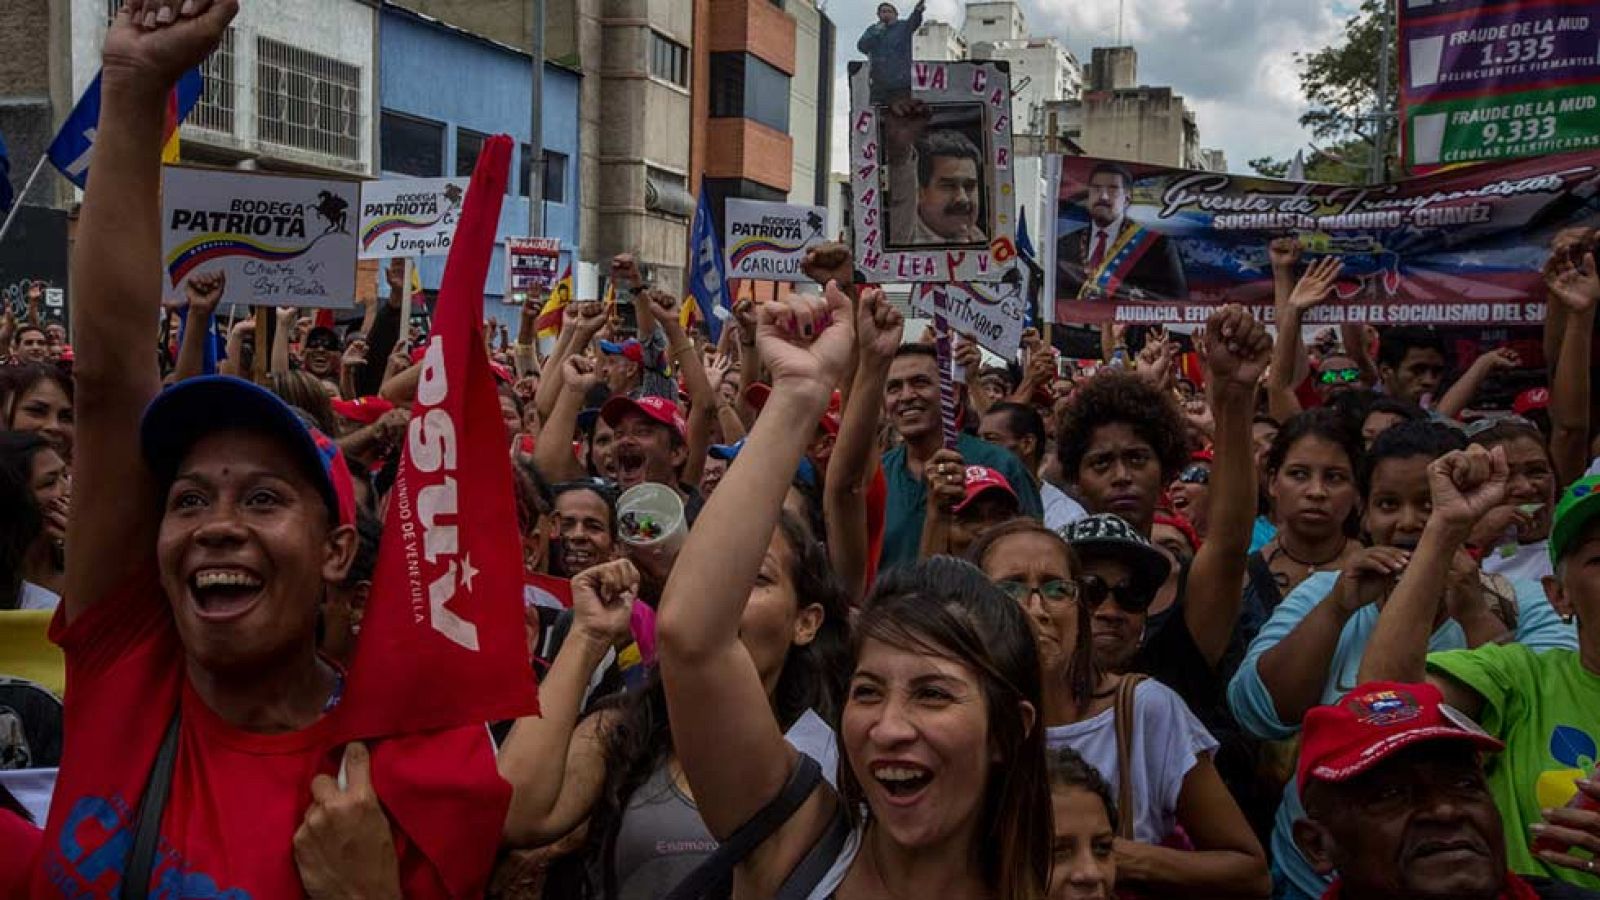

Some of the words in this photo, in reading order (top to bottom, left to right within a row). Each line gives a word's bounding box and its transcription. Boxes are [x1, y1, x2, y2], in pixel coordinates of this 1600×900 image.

[1450, 25, 1508, 46] FRAUDE
[1512, 22, 1532, 37] DE
[1534, 18, 1553, 34] LA
[1557, 17, 1589, 32] MUD
[1480, 36, 1556, 66] 1.335
[1530, 57, 1594, 71] FIRMANTES
[1452, 107, 1510, 125] FRAUDE
[1513, 103, 1533, 118] DE
[1536, 99, 1554, 115] LA
[1559, 95, 1596, 112] MUD
[1482, 115, 1557, 146] 9.333
[396, 193, 437, 202] BODEGA
[1158, 174, 1275, 219] Frente
[230, 199, 305, 216] BODEGA
[364, 201, 438, 216] PATRIOTA
[1416, 202, 1491, 227] CHAVÉZ
[170, 208, 307, 238] PATRIOTA
[731, 221, 802, 239] PATRIOTA
[741, 257, 806, 274] CARICUA
[1114, 304, 1183, 322] AUDACIA,
[1348, 304, 1368, 322] EN
[1370, 304, 1386, 322] EL
[1388, 304, 1489, 322] SOCIALISMO
[1491, 304, 1522, 322] DEL
